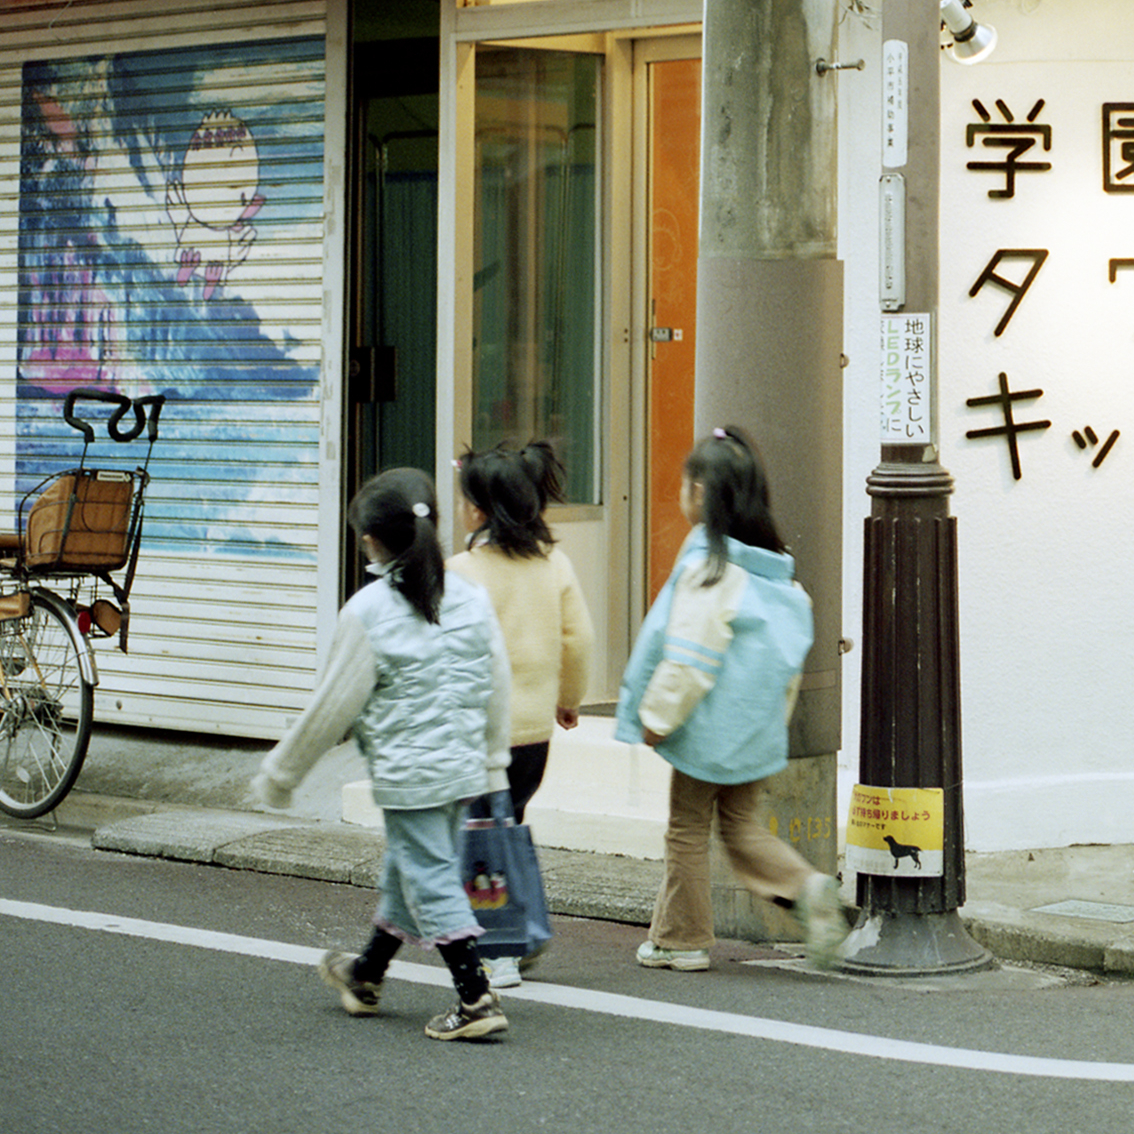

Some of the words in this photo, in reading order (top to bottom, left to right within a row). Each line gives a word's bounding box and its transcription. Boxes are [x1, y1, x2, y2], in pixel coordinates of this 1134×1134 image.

[904, 318, 925, 438] 地球にやさしい
